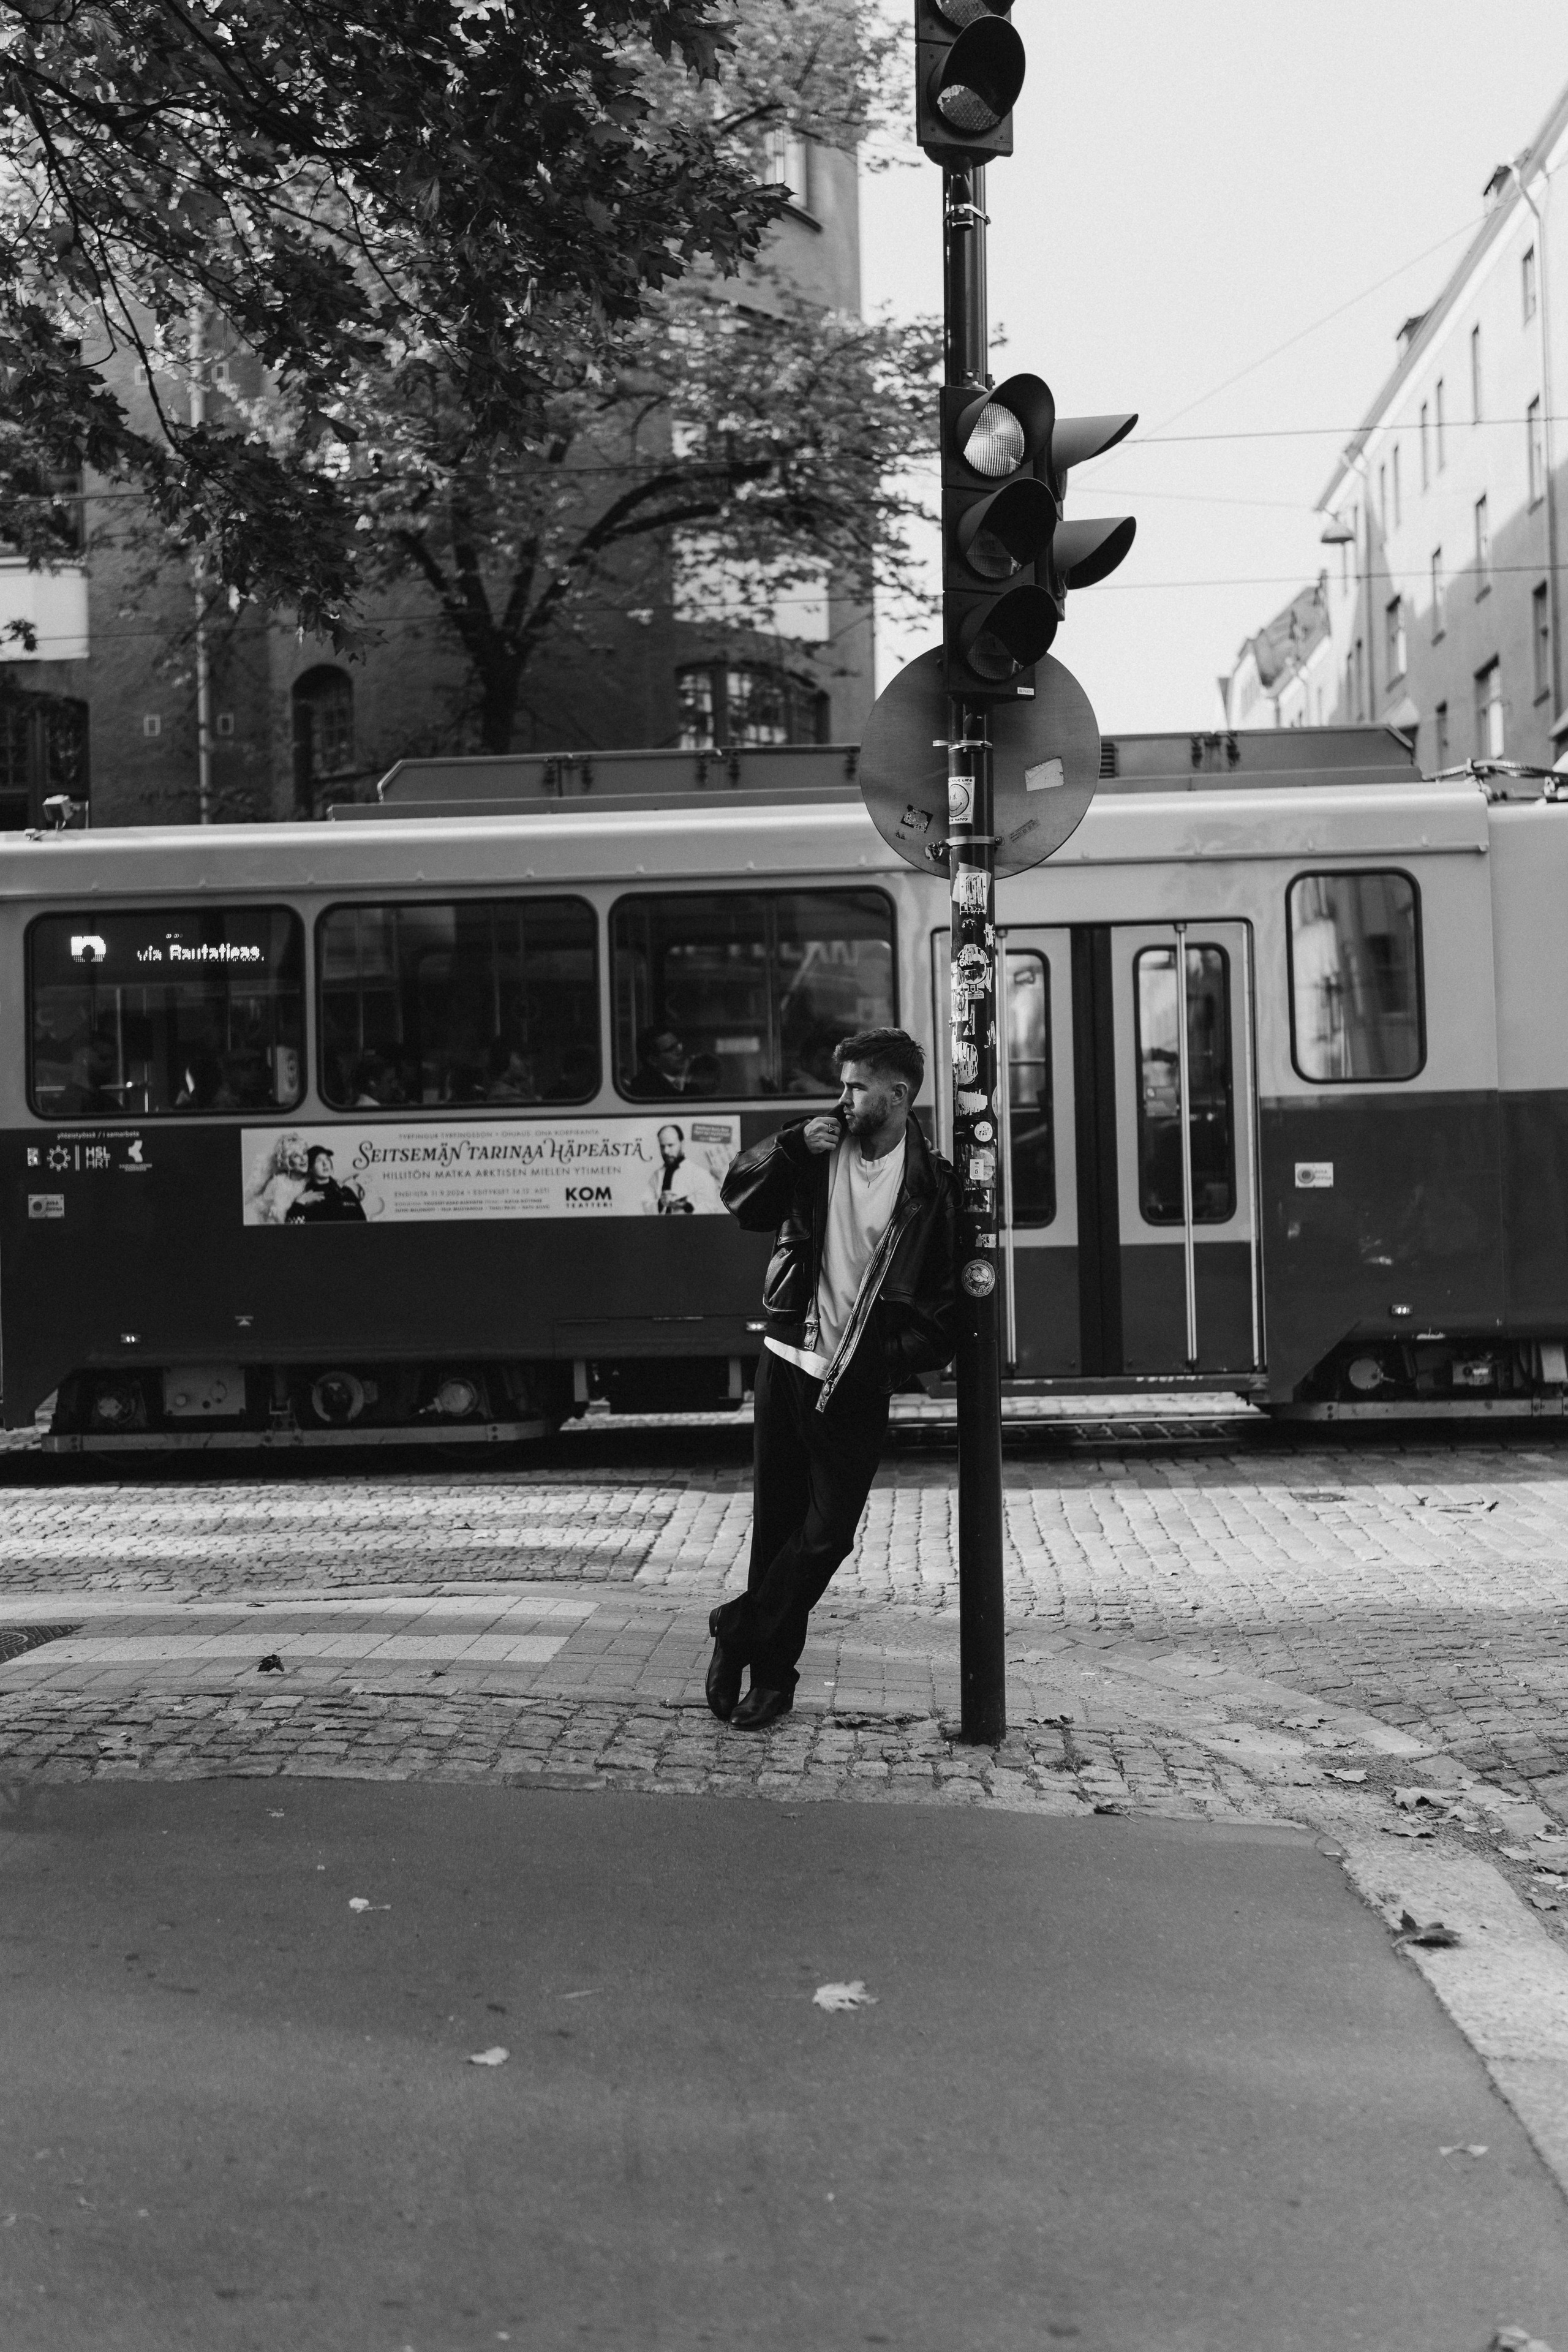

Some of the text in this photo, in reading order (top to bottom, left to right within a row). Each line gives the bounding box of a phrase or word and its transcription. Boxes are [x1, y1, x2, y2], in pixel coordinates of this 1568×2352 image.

[85, 1145, 111, 1158] HSL
[352, 1137, 653, 1170] SEITSEMÄN TARINAA HÄPEÄSTÄ
[85, 1157, 110, 1169] HRT
[382, 1165, 622, 1180] HILLITÖN MATKA ARKTISEN MIELEN YTIMEEN
[565, 1186, 612, 1201] KOM
